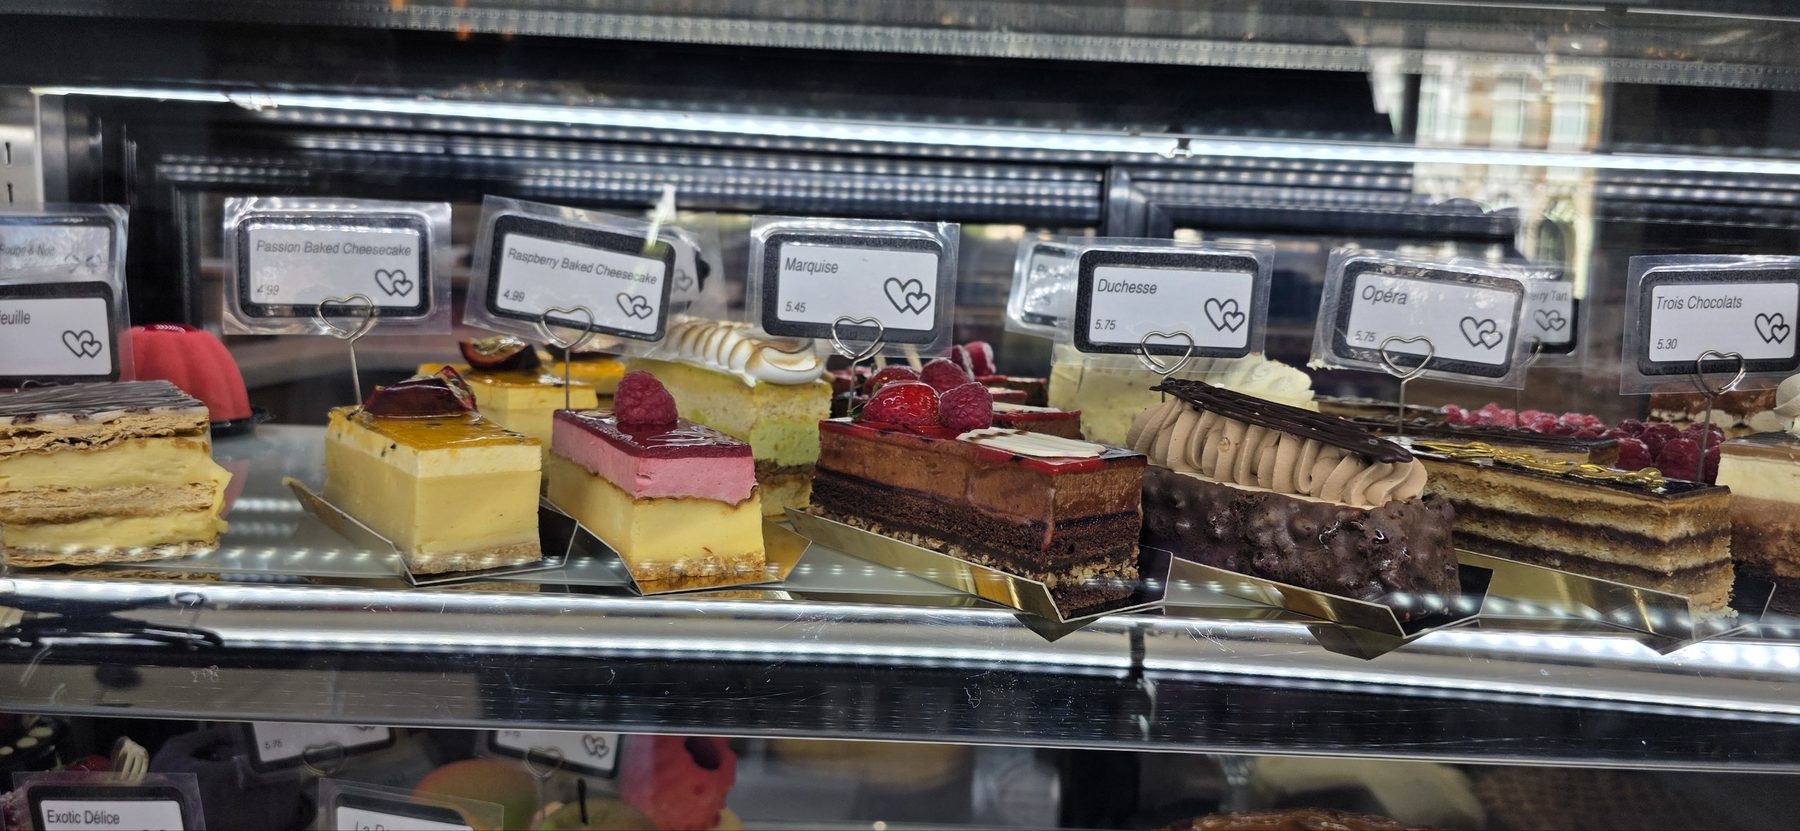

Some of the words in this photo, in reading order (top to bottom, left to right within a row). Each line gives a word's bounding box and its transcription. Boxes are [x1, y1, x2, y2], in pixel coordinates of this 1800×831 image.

[257, 239, 300, 252] Passion
[305, 241, 340, 254] Baked
[343, 242, 412, 256] Cheesecake
[508, 247, 560, 270] Raspberry
[561, 257, 594, 273] Baked
[595, 264, 658, 285] Cheesecake
[785, 257, 839, 275] Marquise
[1097, 278, 1158, 295] Duchesse
[504, 288, 525, 302] 4.99
[1362, 285, 1408, 306] Opéra
[1656, 296, 1684, 310] Trois
[1687, 295, 1743, 310] Chocolats
[785, 301, 806, 314] 5.45
[1094, 319, 1117, 331] 5.75
[1354, 330, 1377, 343] 5.75
[1656, 338, 1678, 350] 5.30
[47, 809, 81, 824] Exotic
[84, 810, 120, 825] Délice
